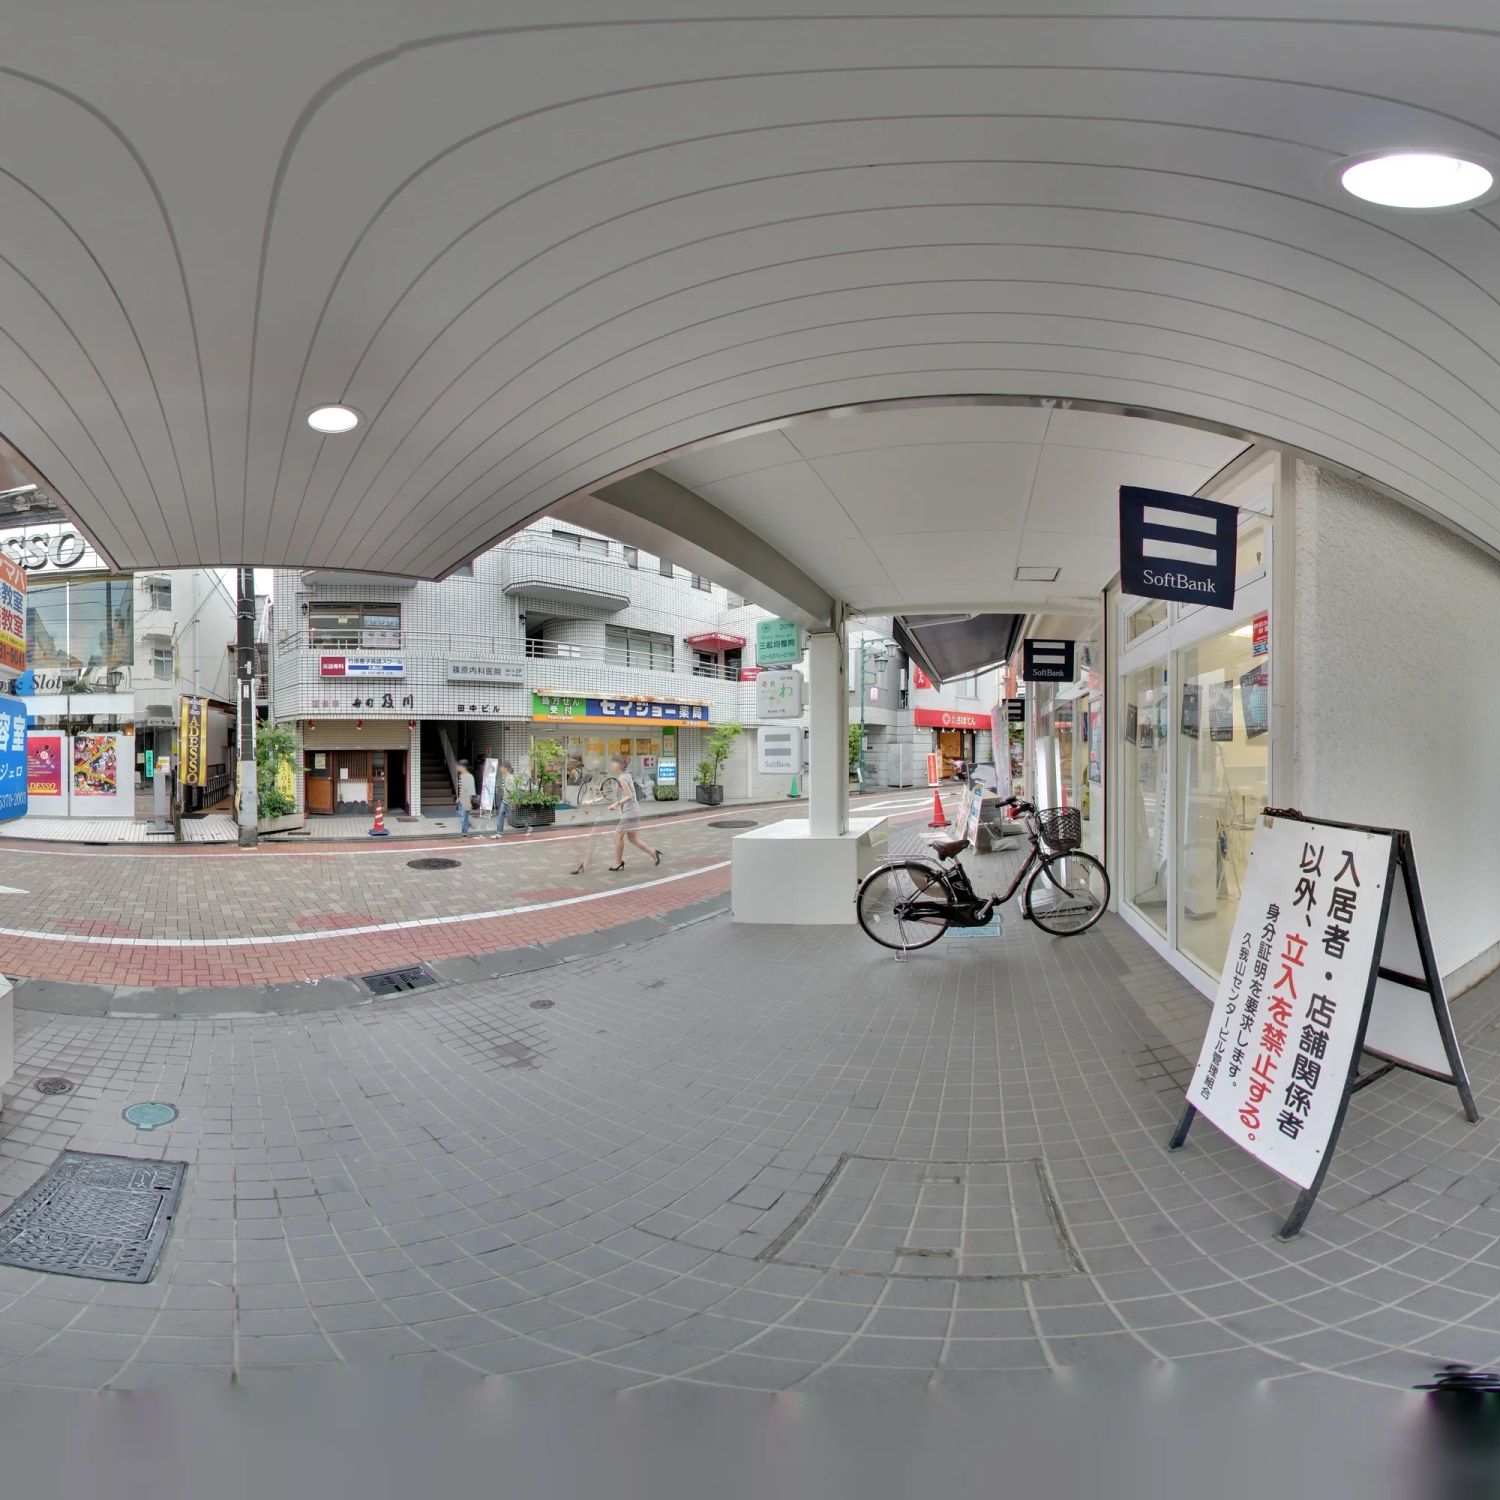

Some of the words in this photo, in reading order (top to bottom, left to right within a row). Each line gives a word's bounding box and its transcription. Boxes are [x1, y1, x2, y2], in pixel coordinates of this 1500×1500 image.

[1143, 569, 1217, 594] SoftBank
[29, 674, 64, 690] Slot
[1032, 668, 1065, 678] SoftBank
[457, 704, 500, 713] 田中ビル
[549, 706, 572, 715] 受付
[600, 700, 702, 720] セイジョー薬局
[187, 716, 200, 784] ADESSO
[764, 760, 791, 769] SoftBank
[28, 782, 56, 791] DESSO
[1226, 902, 1281, 1088] 身分証明を要求します。
[1238, 842, 1326, 1142] 以外、立入を禁止する。
[1276, 849, 1361, 1141] 入居者・店舗関係者
[1200, 932, 1252, 1101] 久我山センタービル管理組合
